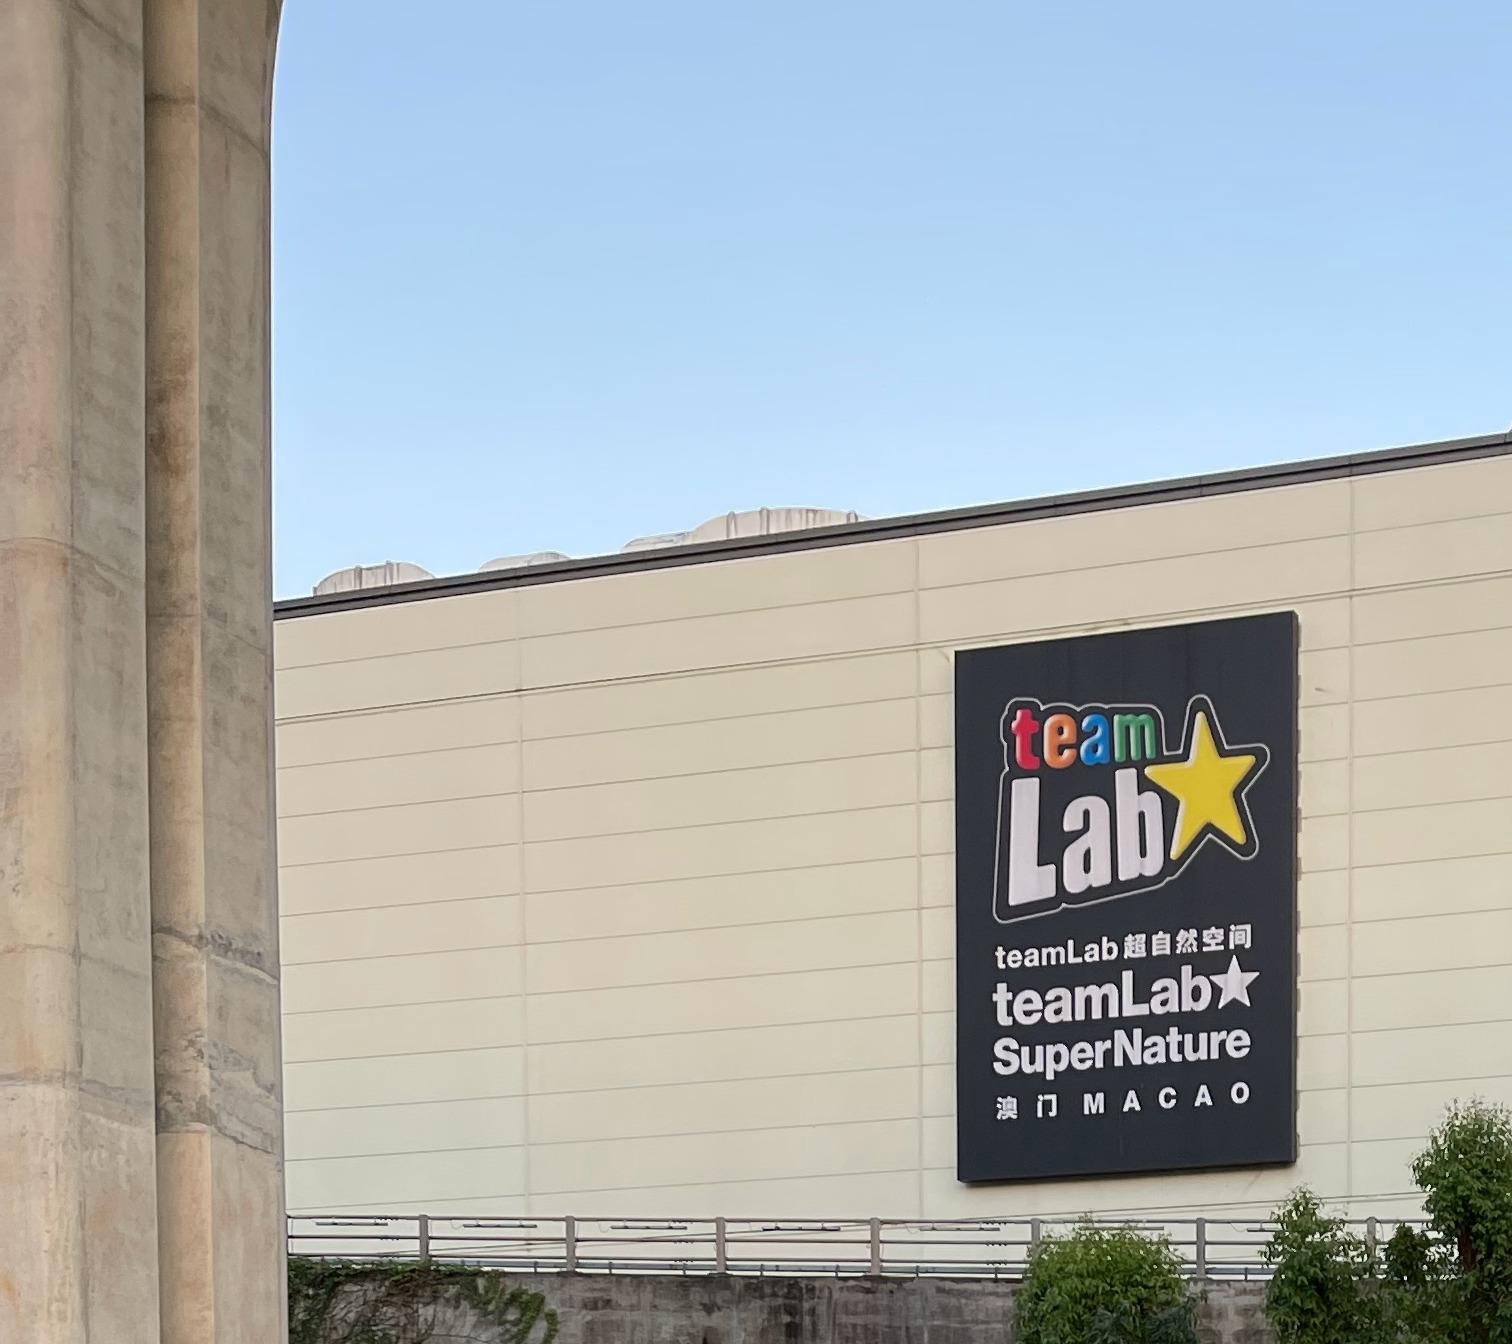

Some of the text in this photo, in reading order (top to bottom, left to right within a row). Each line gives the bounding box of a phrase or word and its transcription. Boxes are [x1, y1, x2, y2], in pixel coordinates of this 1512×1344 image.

[1012, 708, 1157, 771] team
[1008, 767, 1164, 907] Lab
[995, 923, 1252, 970] teamLab 超自然空间
[992, 964, 1212, 1027] teamLab
[996, 1081, 1250, 1120] 澳门 MACAO
